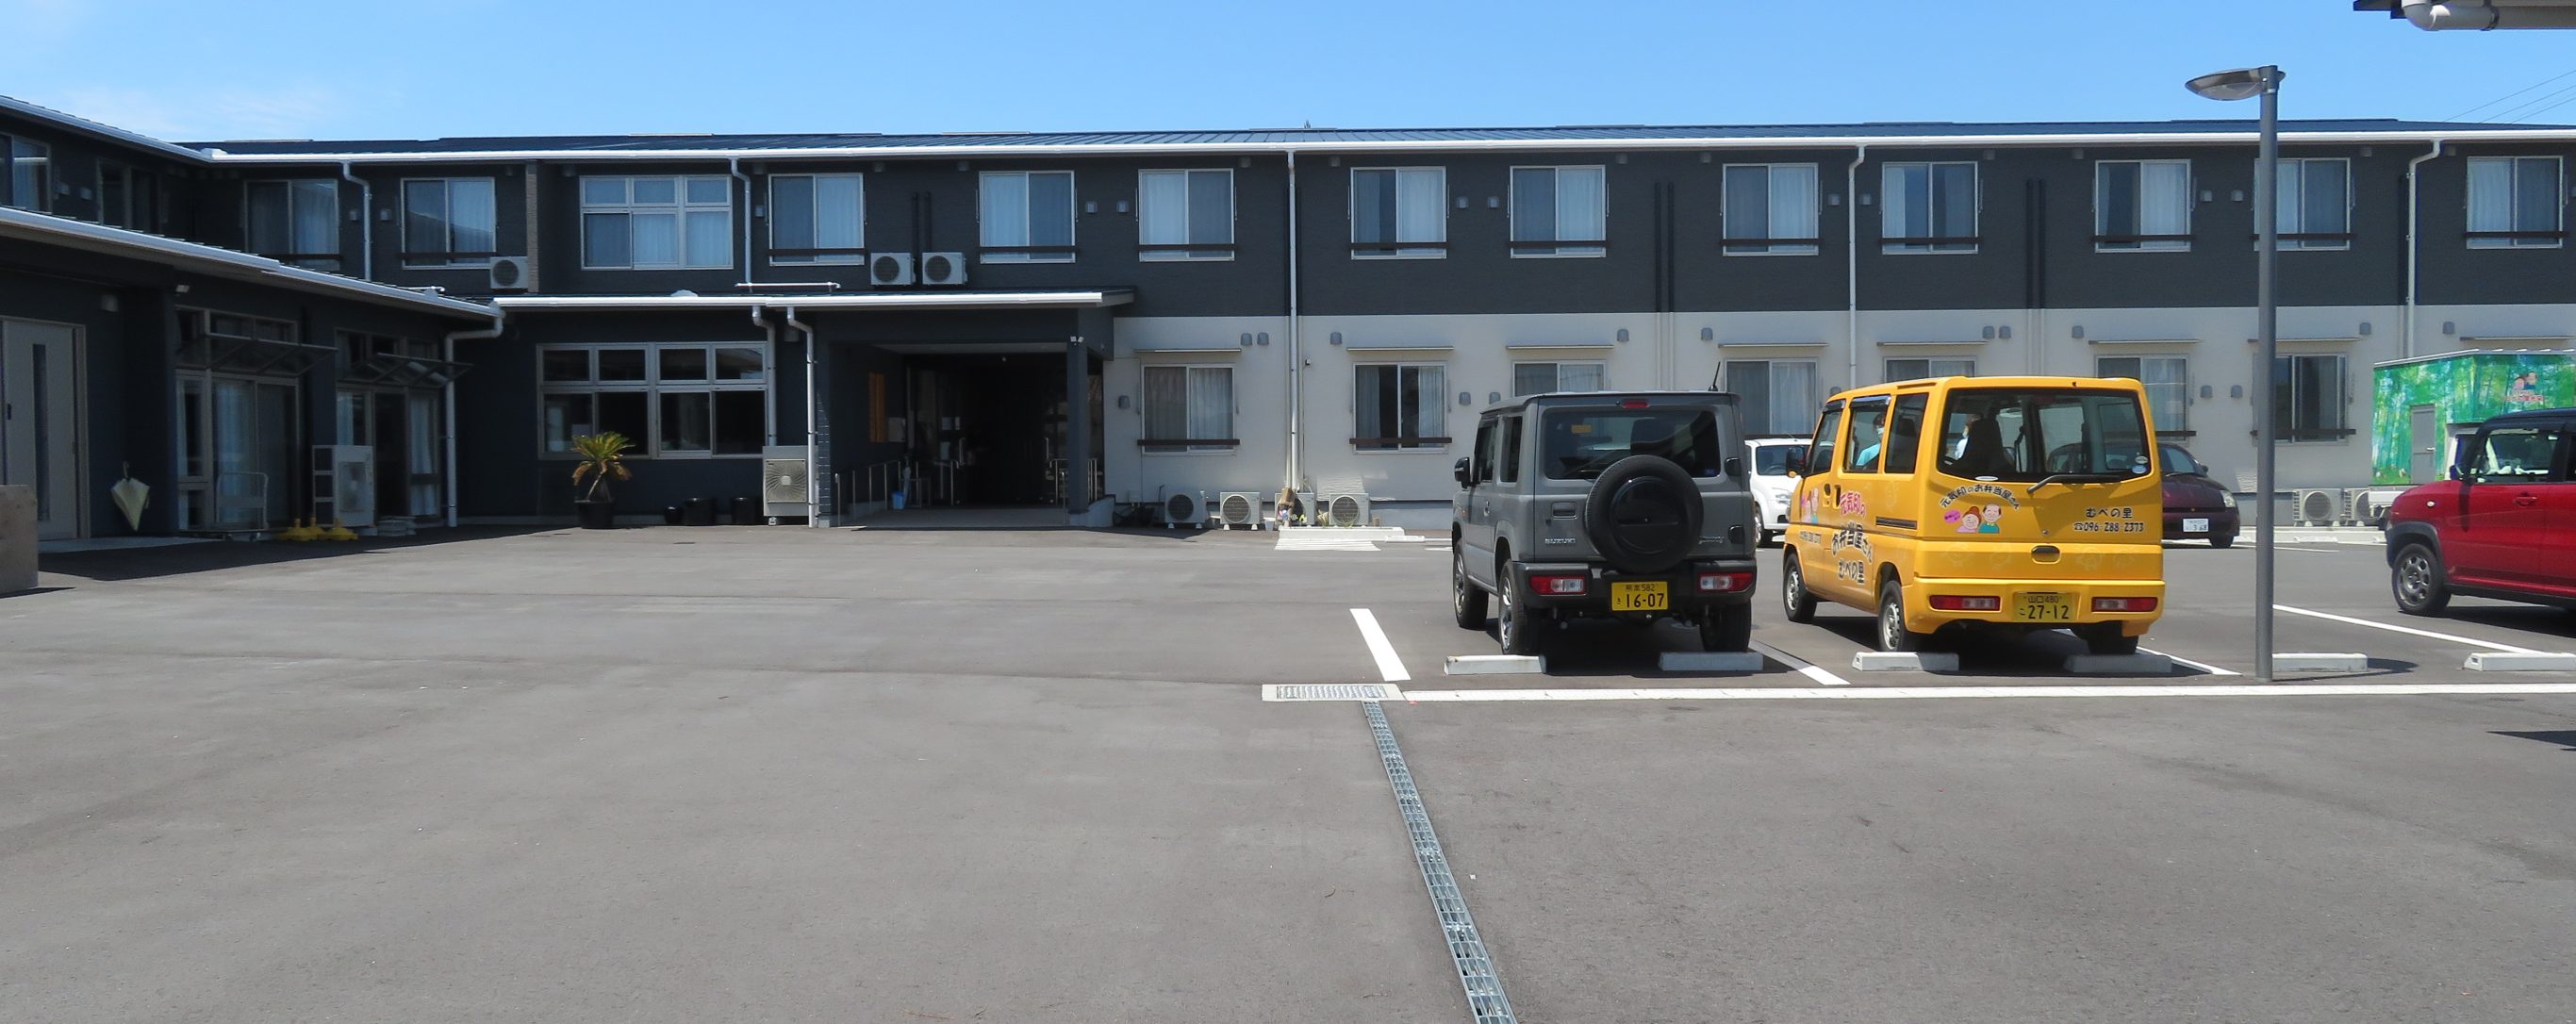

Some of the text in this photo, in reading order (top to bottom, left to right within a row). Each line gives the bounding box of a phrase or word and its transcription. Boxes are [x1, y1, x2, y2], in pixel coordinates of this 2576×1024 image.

[2086, 507, 2133, 519] むべの里
[1627, 593, 1664, 608] 16-07
[2028, 604, 2070, 619] 27-12
